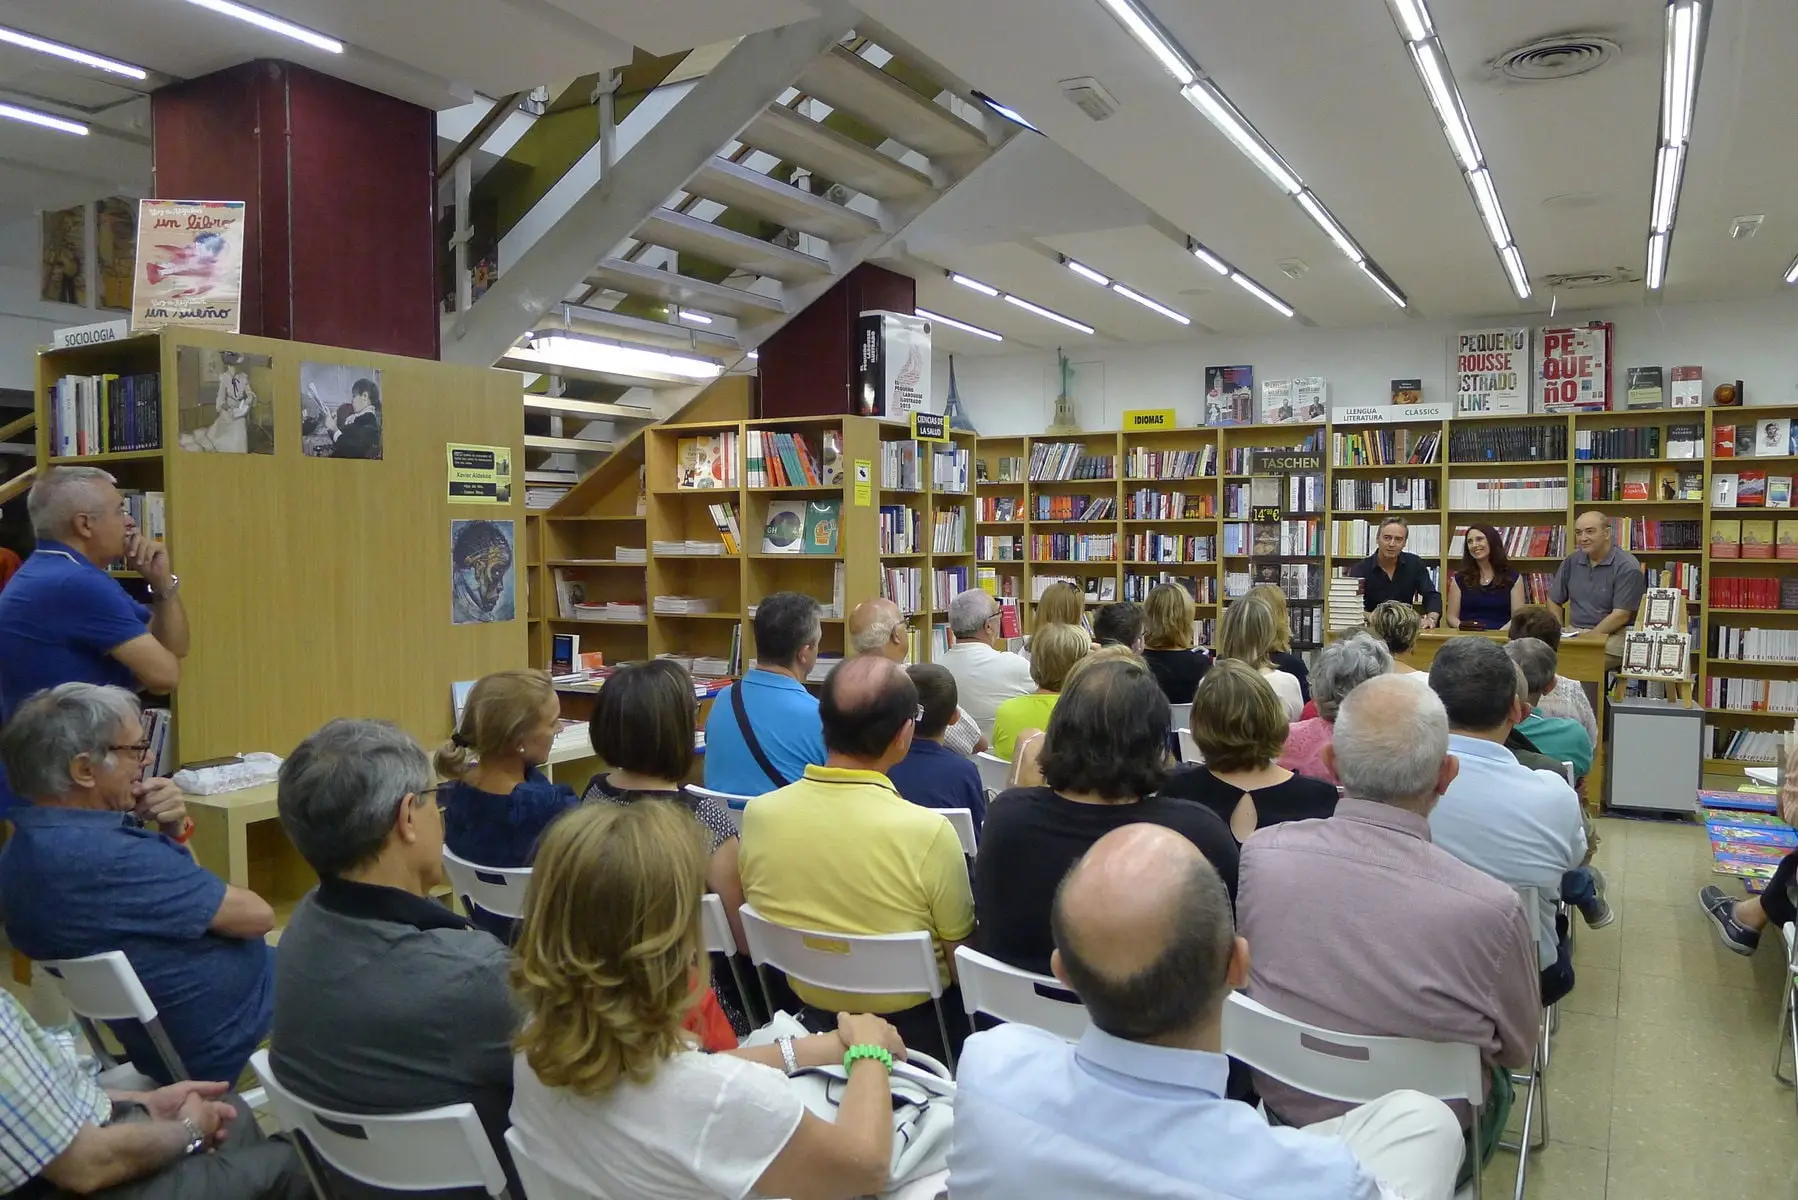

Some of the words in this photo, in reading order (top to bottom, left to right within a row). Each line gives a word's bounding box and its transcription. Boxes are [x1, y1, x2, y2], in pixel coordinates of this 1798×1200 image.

[154, 218, 181, 228] un
[186, 214, 236, 230] libro
[145, 308, 168, 318] un
[172, 306, 231, 319] sueño
[65, 328, 115, 346] SOCIOLOGIA
[917, 416, 937, 425] CIENCIAS
[937, 417, 944, 426] DE
[1134, 415, 1164, 425] IDIOMAS
[1343, 414, 1383, 422] LITERATURA
[920, 427, 927, 435] LA
[927, 427, 941, 436] SALUD
[1261, 457, 1319, 469] TASCHEN
